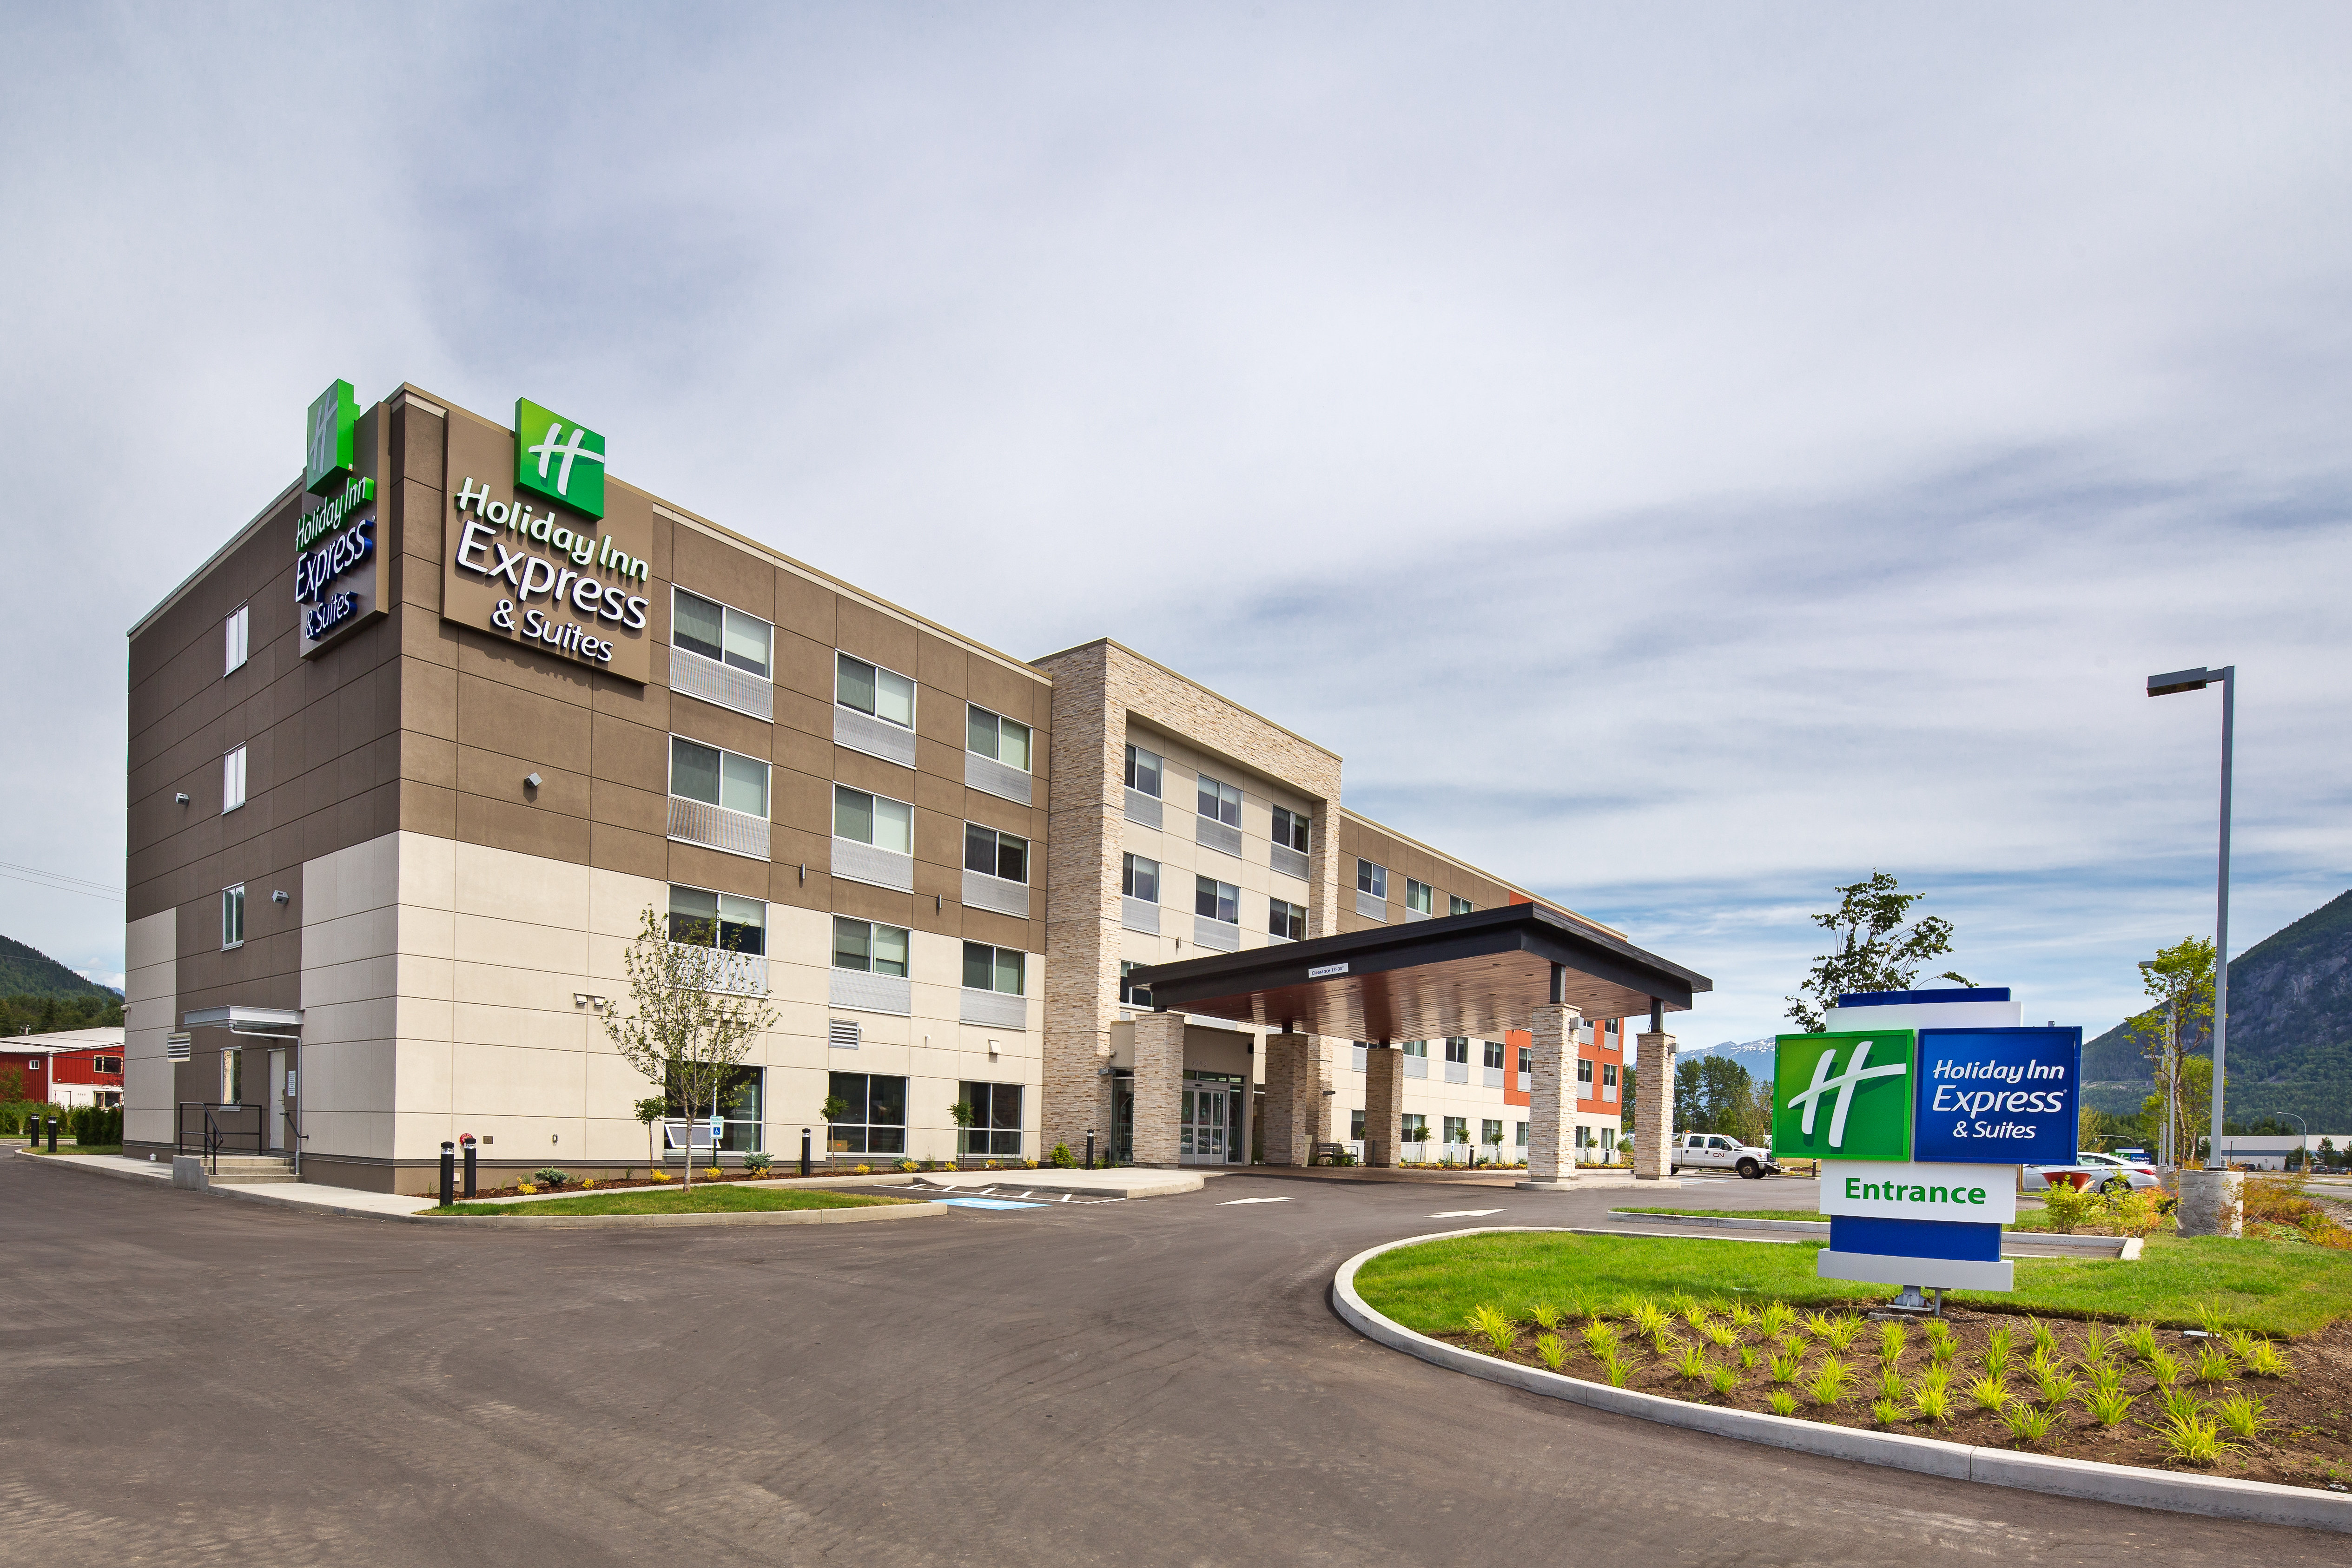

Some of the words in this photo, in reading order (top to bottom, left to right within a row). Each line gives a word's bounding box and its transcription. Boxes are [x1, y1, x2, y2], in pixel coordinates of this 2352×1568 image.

[295, 494, 343, 552] Holiday
[344, 476, 367, 513] Inn
[456, 476, 596, 565] Holiday
[598, 534, 649, 582] Inn
[295, 519, 366, 602] Express
[455, 519, 649, 629] Express
[305, 609, 314, 639] &
[316, 591, 350, 633] Suites
[490, 599, 516, 631] &
[522, 609, 614, 662] Suites
[1932, 1060, 2024, 1084] Holiday
[2027, 1059, 2064, 1079] Inn
[1932, 1085, 2064, 1119] Express
[1953, 1120, 1969, 1138] &
[1972, 1121, 2036, 1139] Suites
[1845, 1177, 1986, 1205] Entrance
